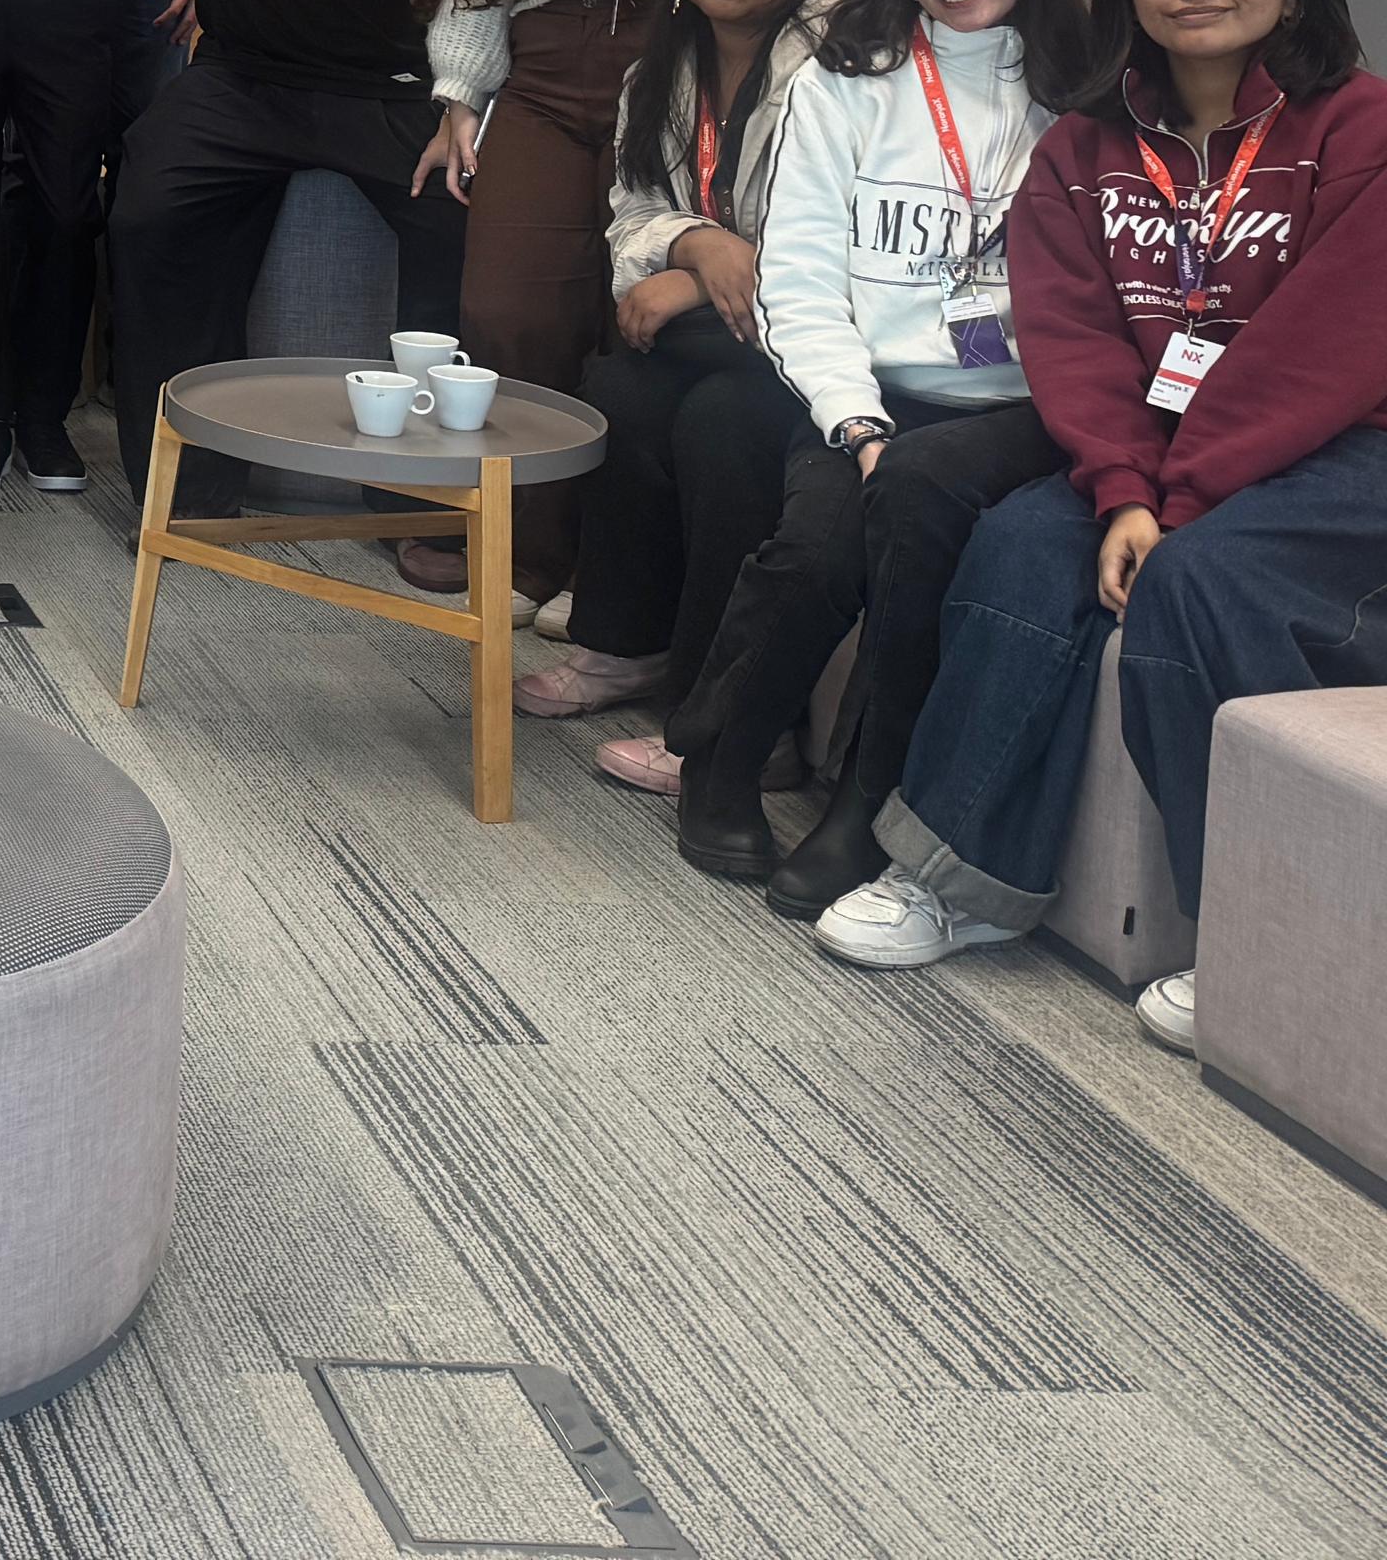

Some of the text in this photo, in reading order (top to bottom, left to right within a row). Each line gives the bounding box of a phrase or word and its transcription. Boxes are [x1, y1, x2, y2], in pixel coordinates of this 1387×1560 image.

[932, 98, 950, 133] NaranjaX
[947, 147, 967, 185] NaranjaX
[1127, 194, 1161, 209] NEW
[1180, 242, 1196, 280] NaranjaX
[1123, 294, 1162, 305] ENDLESS
[1181, 349, 1204, 364] NX
